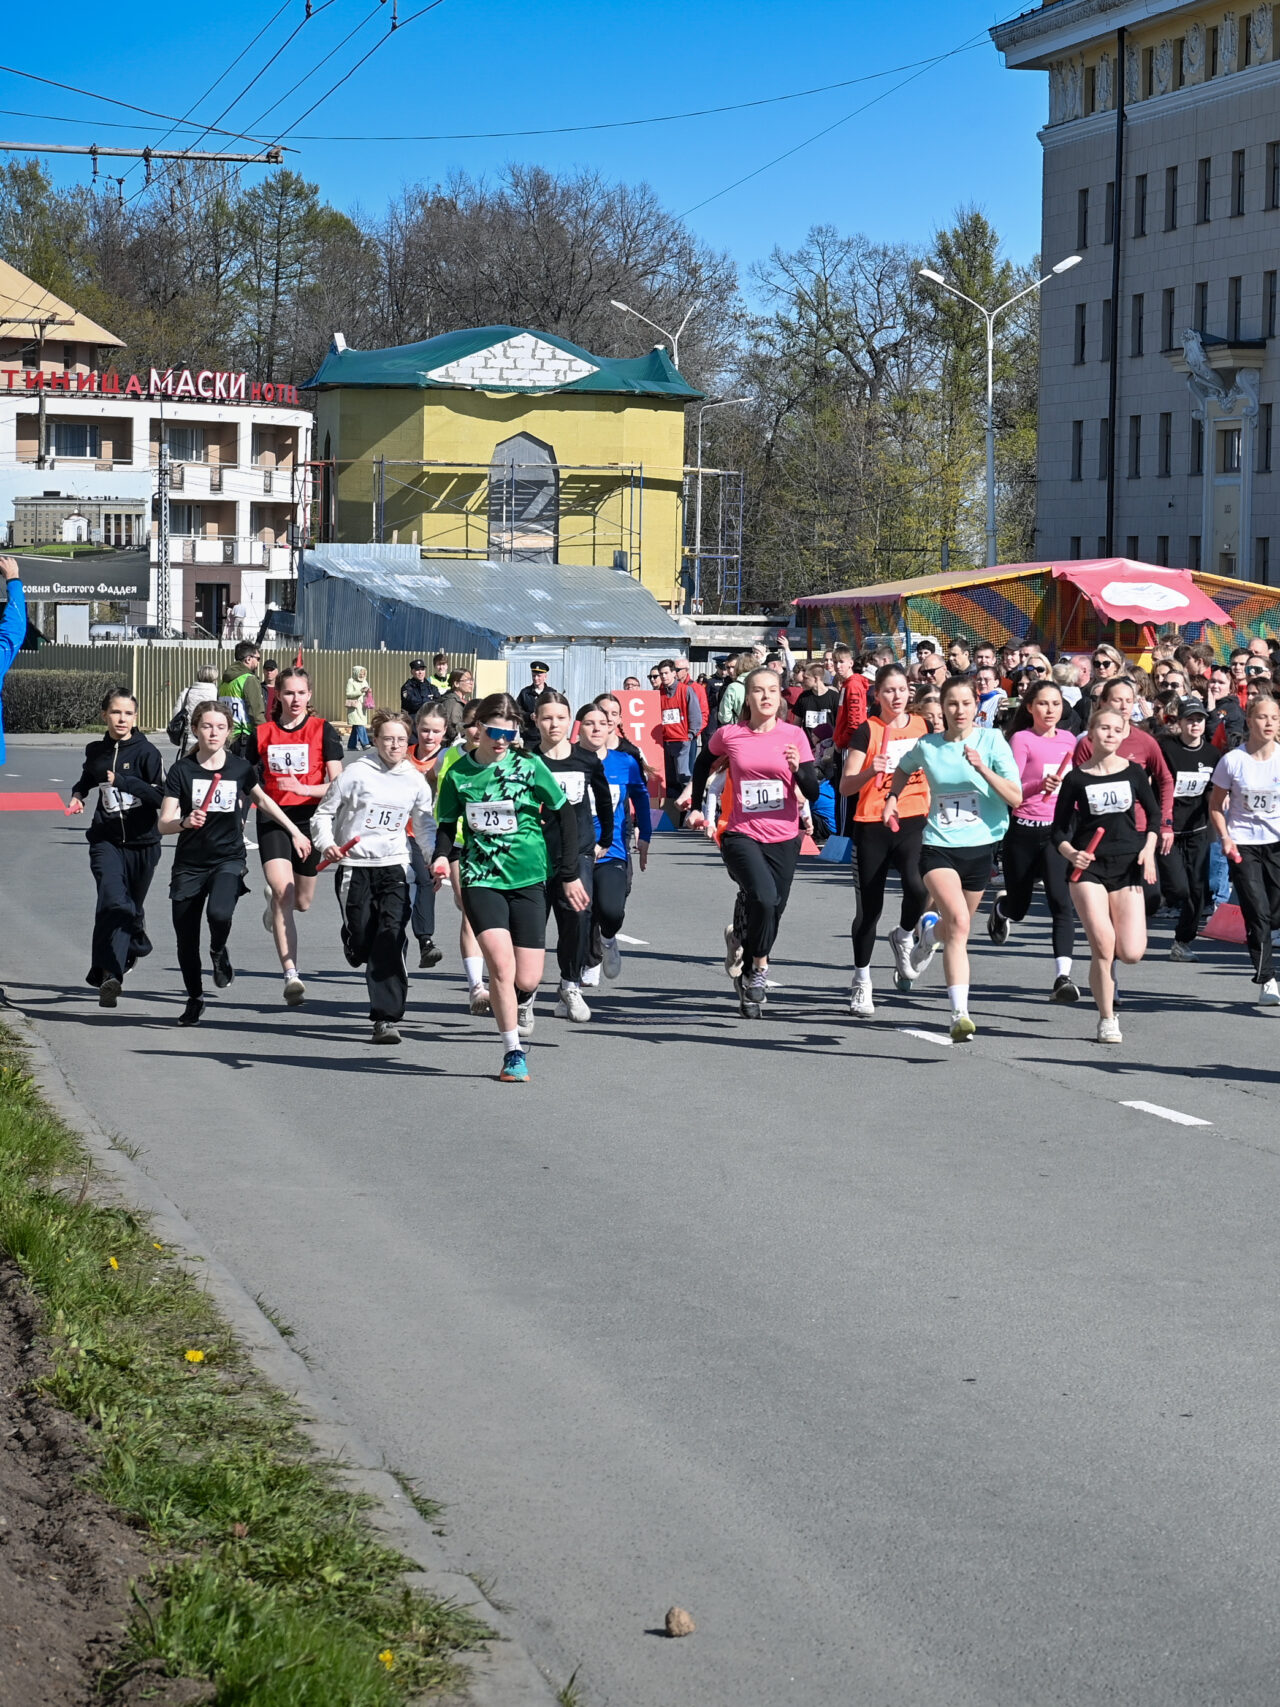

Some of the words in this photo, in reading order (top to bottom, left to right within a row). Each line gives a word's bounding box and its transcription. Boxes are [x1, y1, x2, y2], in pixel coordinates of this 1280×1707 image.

[150, 367, 247, 399] МАСКИ
[252, 381, 300, 404] HOTEL
[52, 582, 95, 594] Святого
[97, 582, 137, 595] Фаддея
[285, 752, 292, 766] 8
[1186, 780, 1198, 791] 19
[756, 788, 769, 805] 10
[1102, 790, 1118, 807] 20
[1253, 795, 1267, 809] 25
[953, 800, 960, 817] 7
[378, 811, 392, 826] 15
[483, 810, 500, 827] 23
